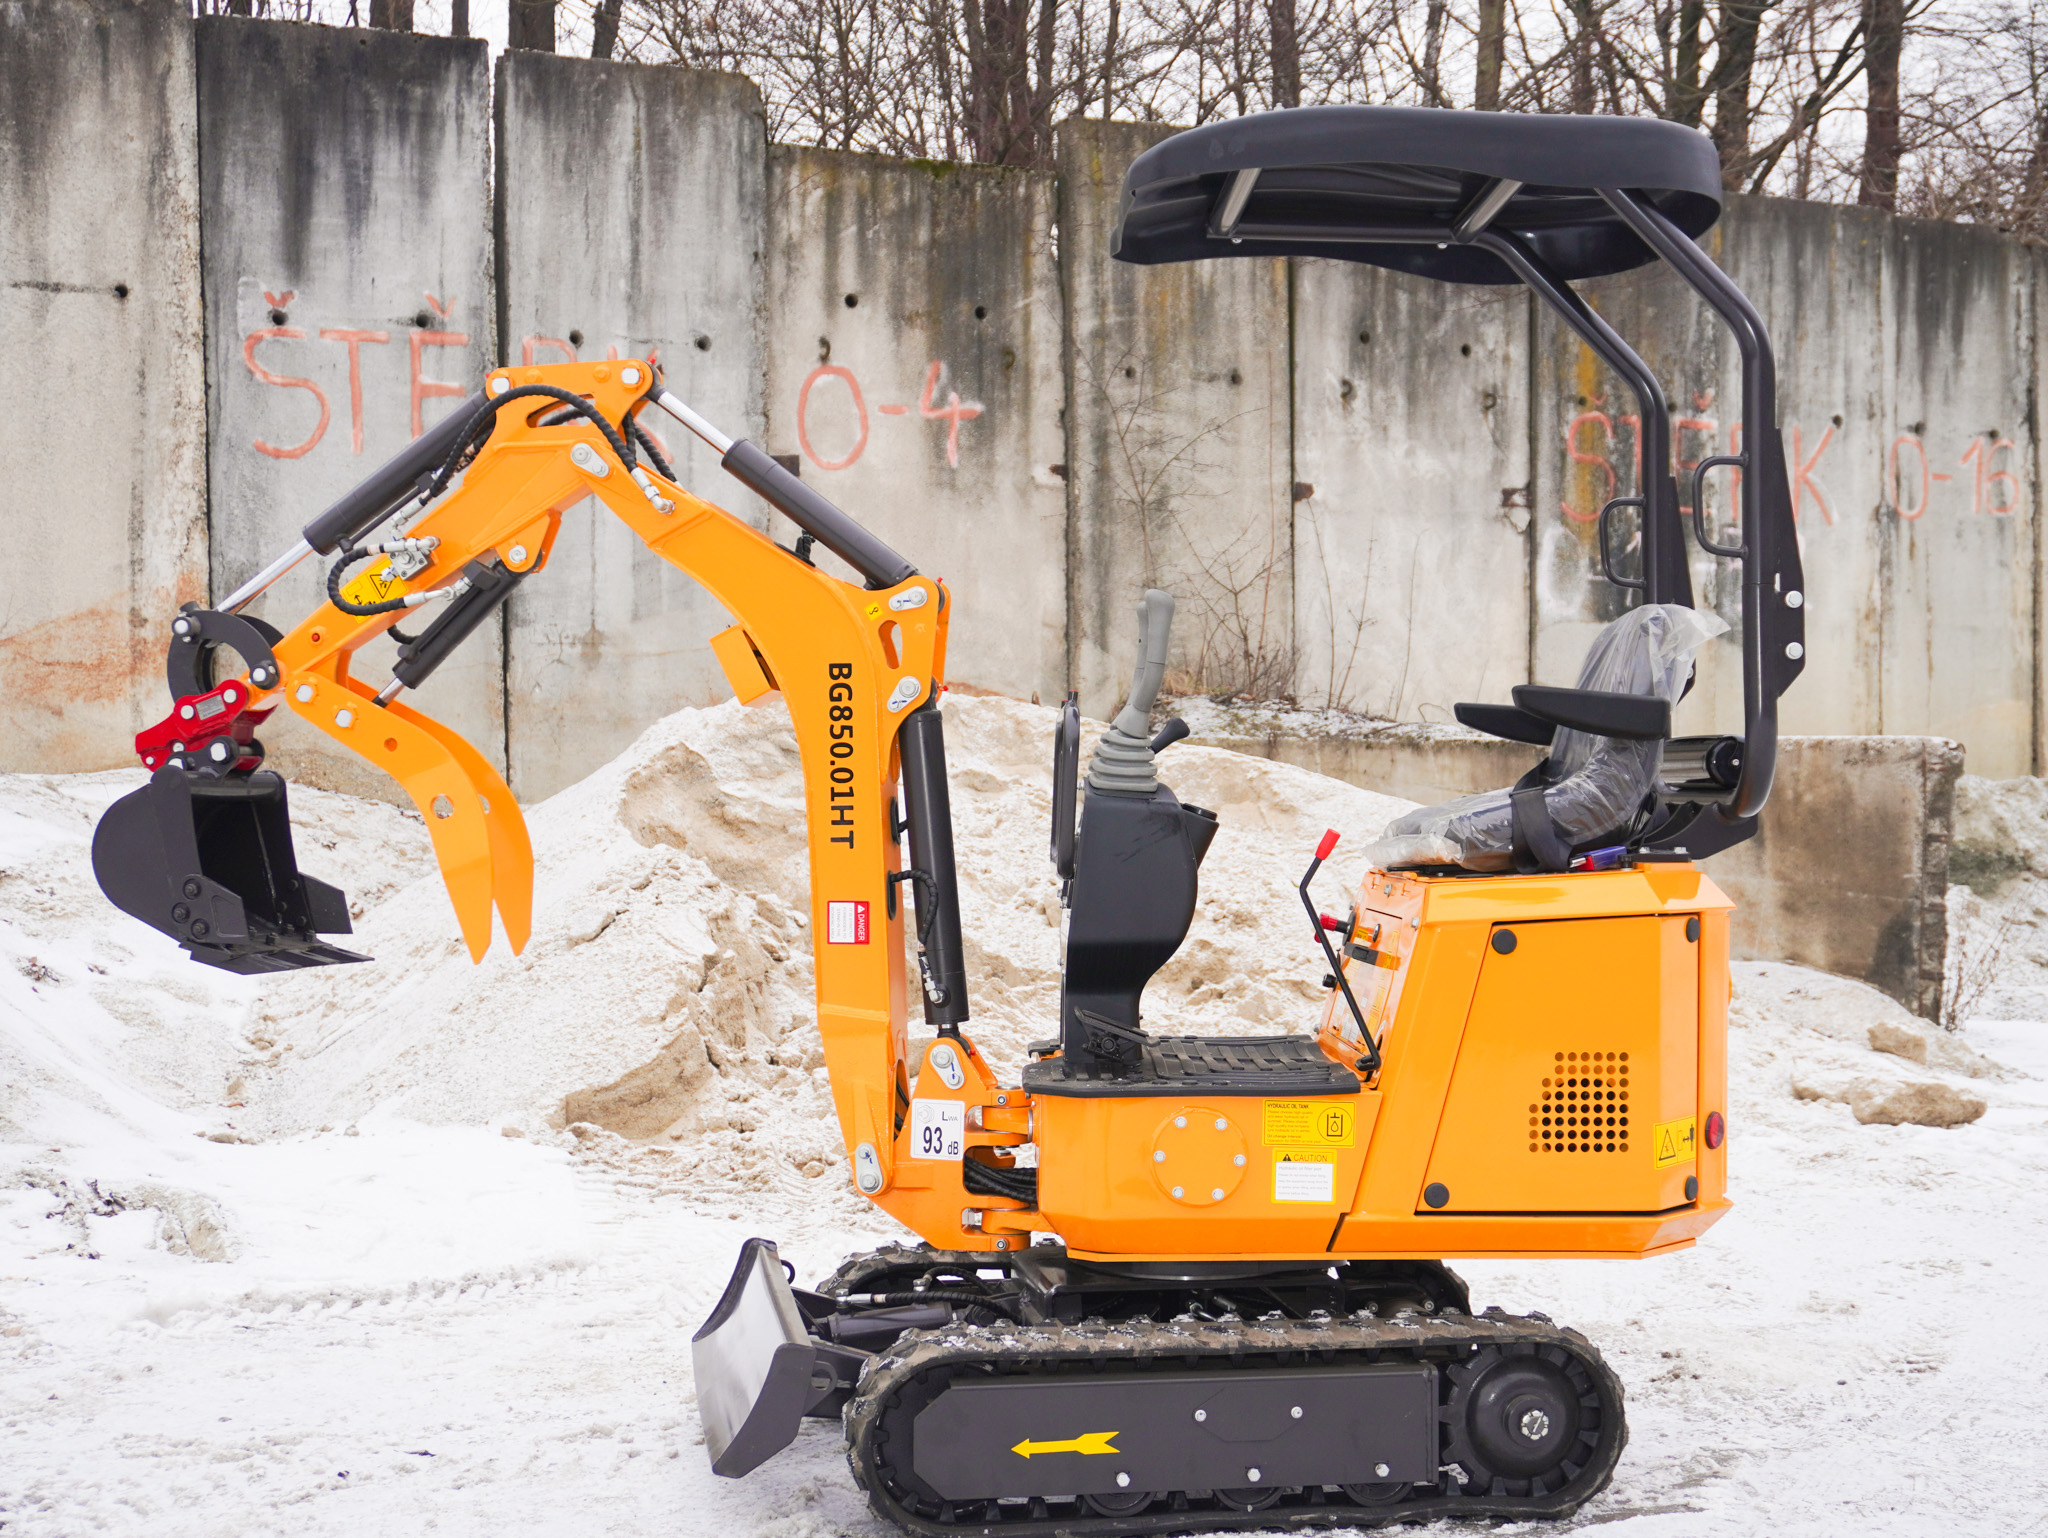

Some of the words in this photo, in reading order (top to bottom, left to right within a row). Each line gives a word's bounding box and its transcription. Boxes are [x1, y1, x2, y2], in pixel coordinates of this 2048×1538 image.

[243, 290, 674, 464] ŠTĚ
[797, 359, 984, 470] 0-4
[1889, 435, 2019, 520] 0-16
[828, 663, 854, 849] BG850.01HT
[857, 914, 865, 941] DANGER
[923, 1126, 942, 1154] 93
[947, 1141, 959, 1155] dB
[1293, 1153, 1328, 1162] CAUTION
